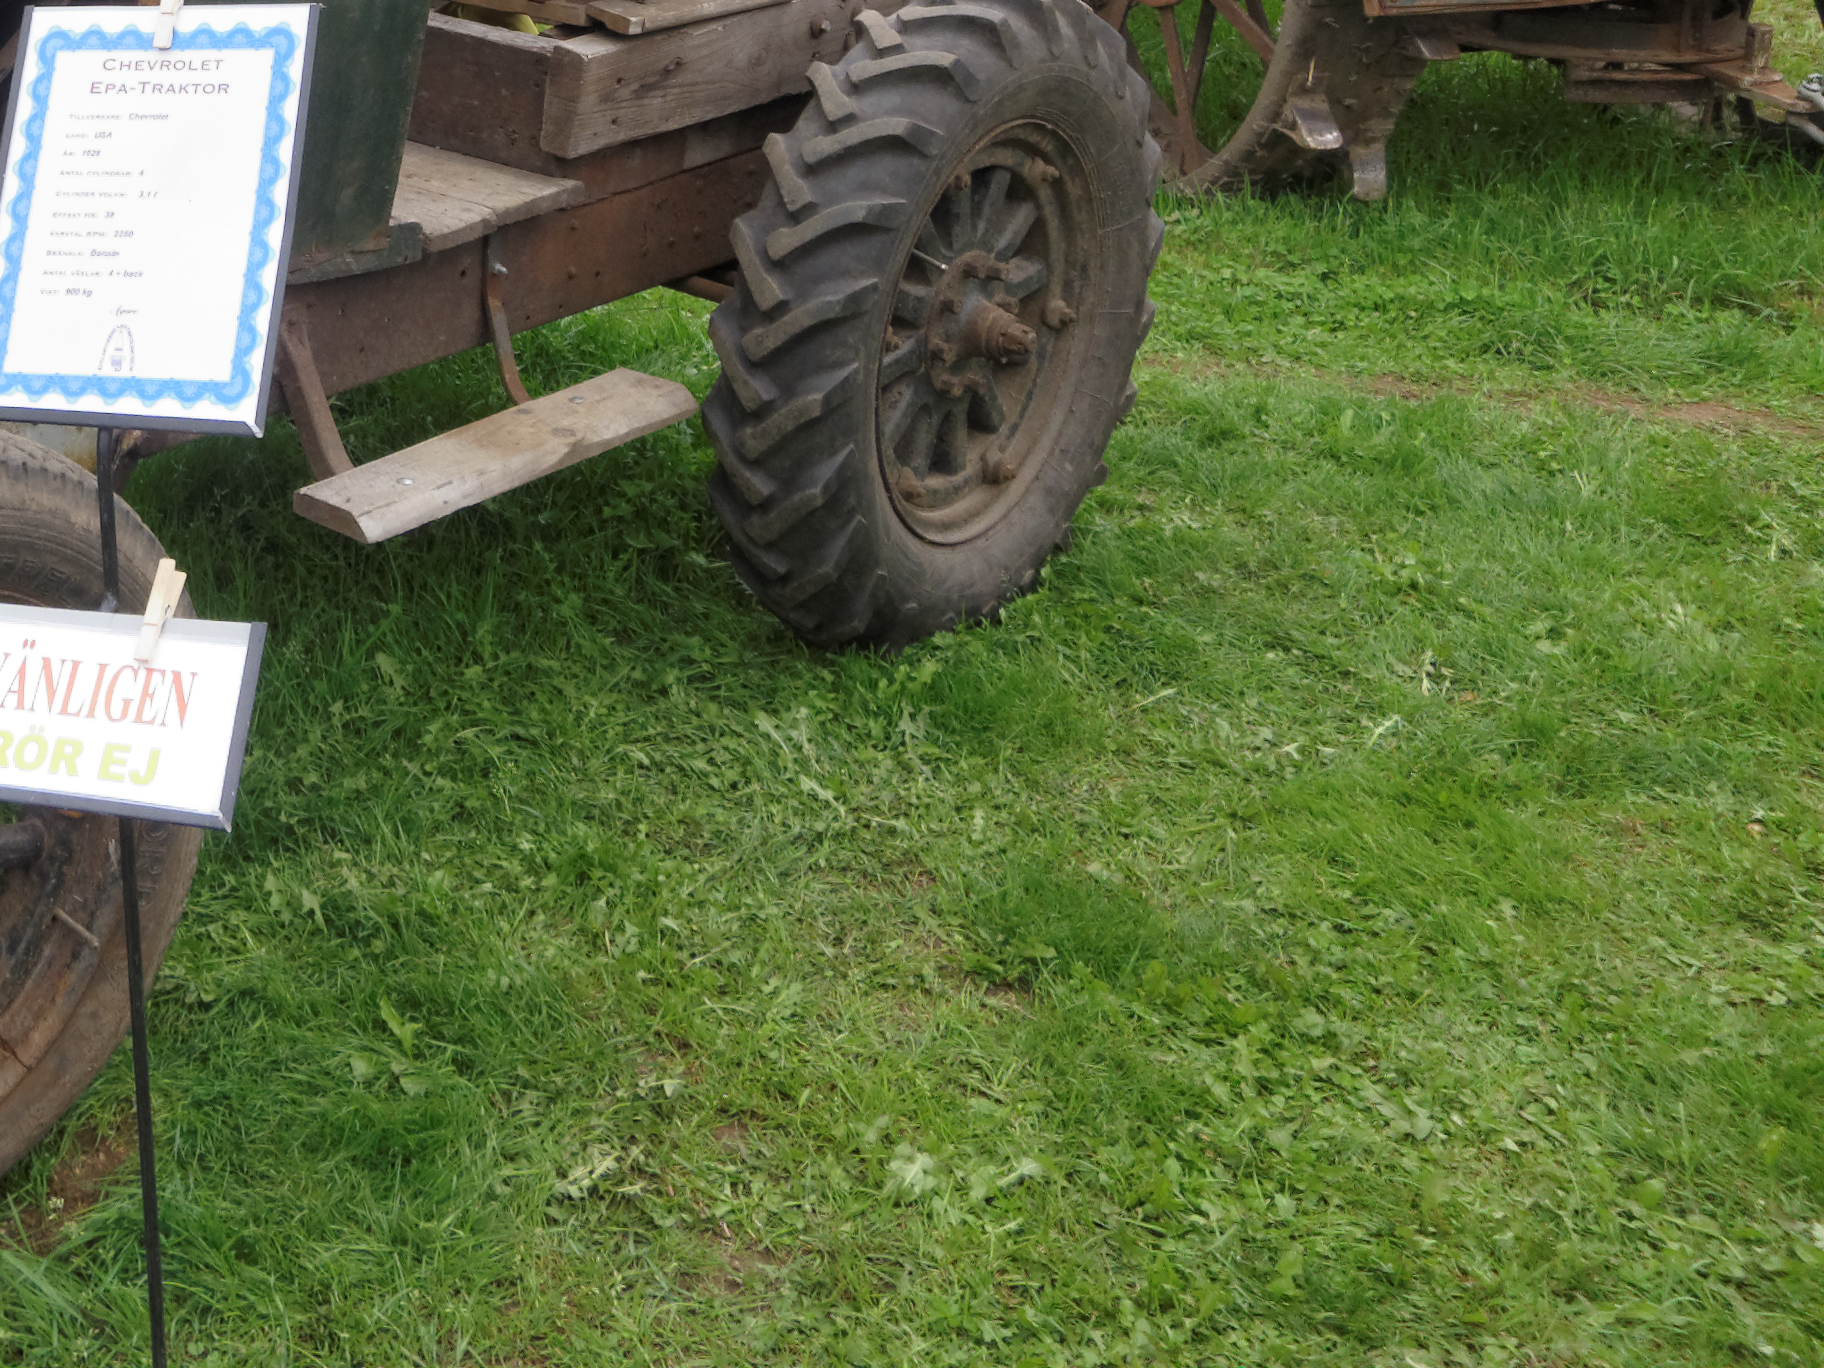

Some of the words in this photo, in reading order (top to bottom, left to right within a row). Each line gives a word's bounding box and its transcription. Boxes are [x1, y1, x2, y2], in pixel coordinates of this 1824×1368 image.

[102, 58, 224, 71] CHEVROLET
[89, 81, 230, 95] EPA-TRAKTOR
[128, 112, 169, 121] Chevrolet
[94, 131, 113, 139] USA
[97, 742, 162, 786] EJ
